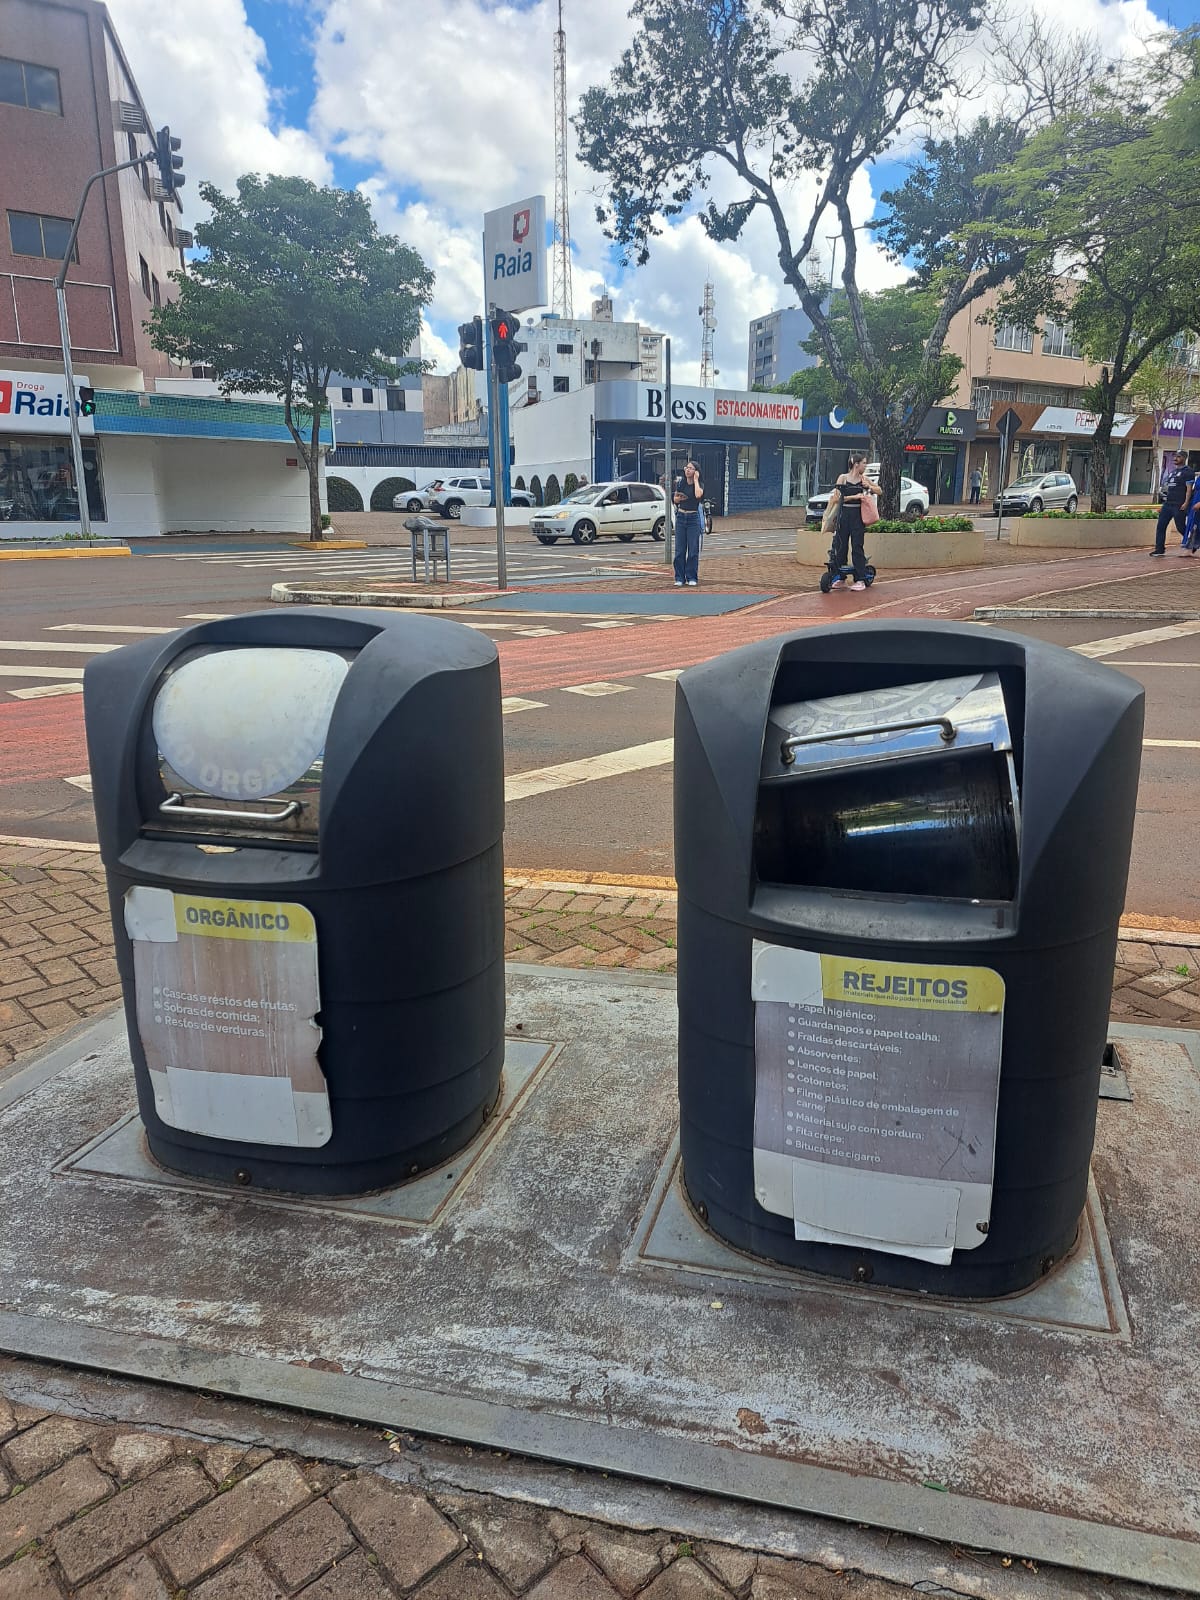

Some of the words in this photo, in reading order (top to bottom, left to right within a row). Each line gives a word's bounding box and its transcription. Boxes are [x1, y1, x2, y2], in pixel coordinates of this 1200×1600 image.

[494, 248, 532, 280] Raia
[16, 382, 45, 391] Droga
[716, 400, 800, 421] ESTACIONAMENTO
[788, 690, 957, 742] REEITOS
[186, 906, 290, 931] ORGÂNICO
[843, 970, 968, 998] REJEITOS
[163, 987, 198, 1002] Cascas
[200, 995, 207, 1003] e
[208, 993, 242, 1008] restos
[244, 996, 258, 1008] de
[260, 999, 298, 1012] frutas;
[163, 1002, 200, 1016] Sobras
[201, 1007, 214, 1018] de
[216, 1011, 260, 1024] comida;
[164, 1015, 200, 1029] Restos
[201, 1020, 215, 1032] de
[799, 1003, 826, 1015] Papel
[827, 1006, 877, 1022] higiênico;
[797, 1017, 864, 1035] Guardanapos
[865, 1028, 872, 1036] e
[874, 1028, 903, 1039] papel
[904, 1031, 941, 1043] toalha;
[797, 1031, 834, 1046] Fraldas
[835, 1037, 903, 1055] descartáveis;
[797, 1046, 862, 1065] Absorventes;
[797, 1059, 832, 1075] Lenços
[833, 1065, 846, 1076] de
[847, 1068, 879, 1082] papel;
[796, 1073, 849, 1092] Cotonetes;
[796, 1086, 823, 1101] Filme
[825, 1093, 865, 1108] plástico
[866, 1100, 879, 1110] de
[881, 1101, 944, 1117] embalagem
[945, 1106, 960, 1117] de
[796, 1099, 826, 1113] carne;
[795, 1112, 835, 1128] Material
[836, 1120, 857, 1133] sujo
[858, 1125, 880, 1135] com
[882, 1129, 925, 1142] gordura;
[795, 1126, 813, 1138] Fita
[814, 1132, 845, 1145] crepe;
[795, 1139, 830, 1155] Bitucas
[832, 1147, 845, 1158] de
